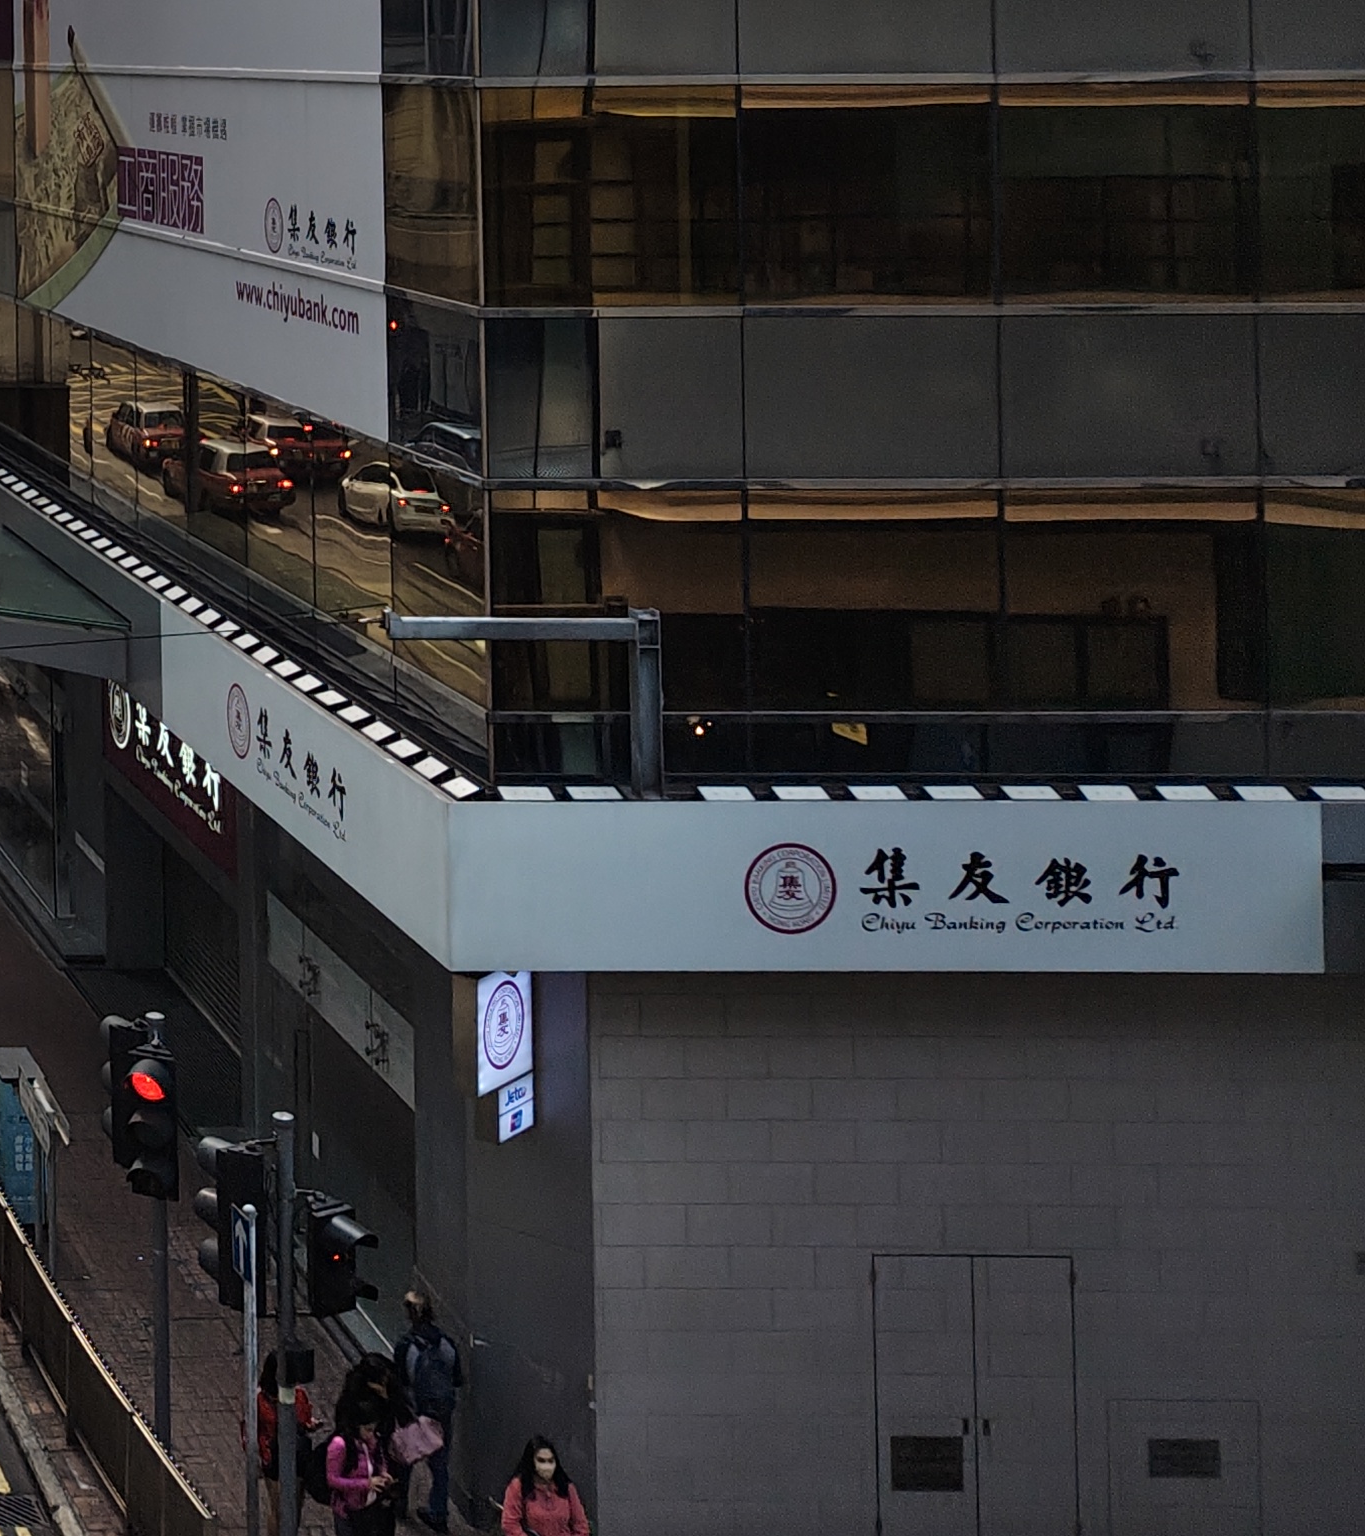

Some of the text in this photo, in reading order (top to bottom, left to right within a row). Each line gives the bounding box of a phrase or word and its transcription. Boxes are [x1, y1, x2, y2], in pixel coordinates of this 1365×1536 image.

[118, 147, 205, 233] 工商服務
[287, 204, 357, 256] 集友銀行
[235, 280, 360, 335] www.chiyubank.com
[134, 702, 222, 813] 集友銀行
[256, 706, 347, 822] 集友銀行
[860, 846, 1180, 909] 集友銀行
[861, 912, 917, 935] Chiyu
[923, 912, 1007, 934] Banking
[1014, 911, 1125, 935] Corporation
